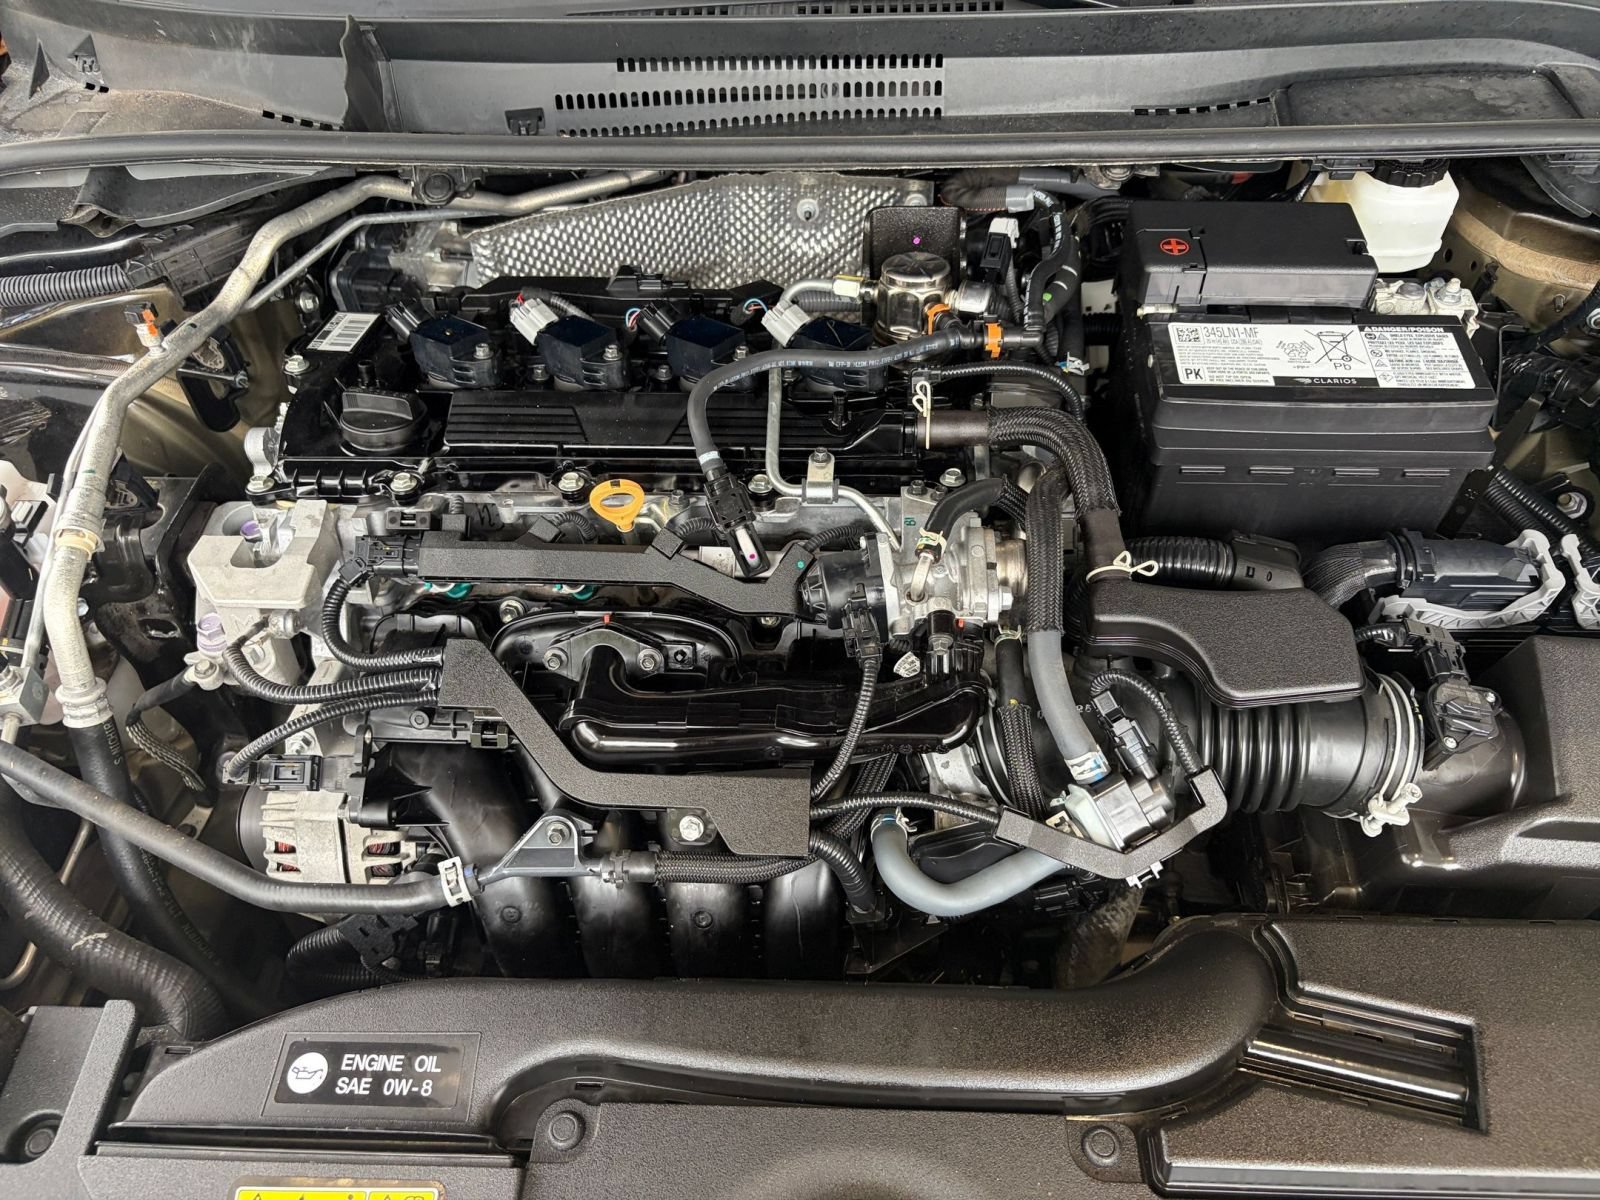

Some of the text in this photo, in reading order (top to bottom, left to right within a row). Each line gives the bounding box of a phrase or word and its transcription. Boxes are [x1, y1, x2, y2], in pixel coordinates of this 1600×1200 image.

[1203, 326, 1259, 338] 345LN1-MF
[1333, 362, 1351, 371] Pb
[1185, 368, 1203, 380] PK
[341, 1054, 442, 1073] ENGINE OIL
[335, 1077, 433, 1097] SAE 0W-8
